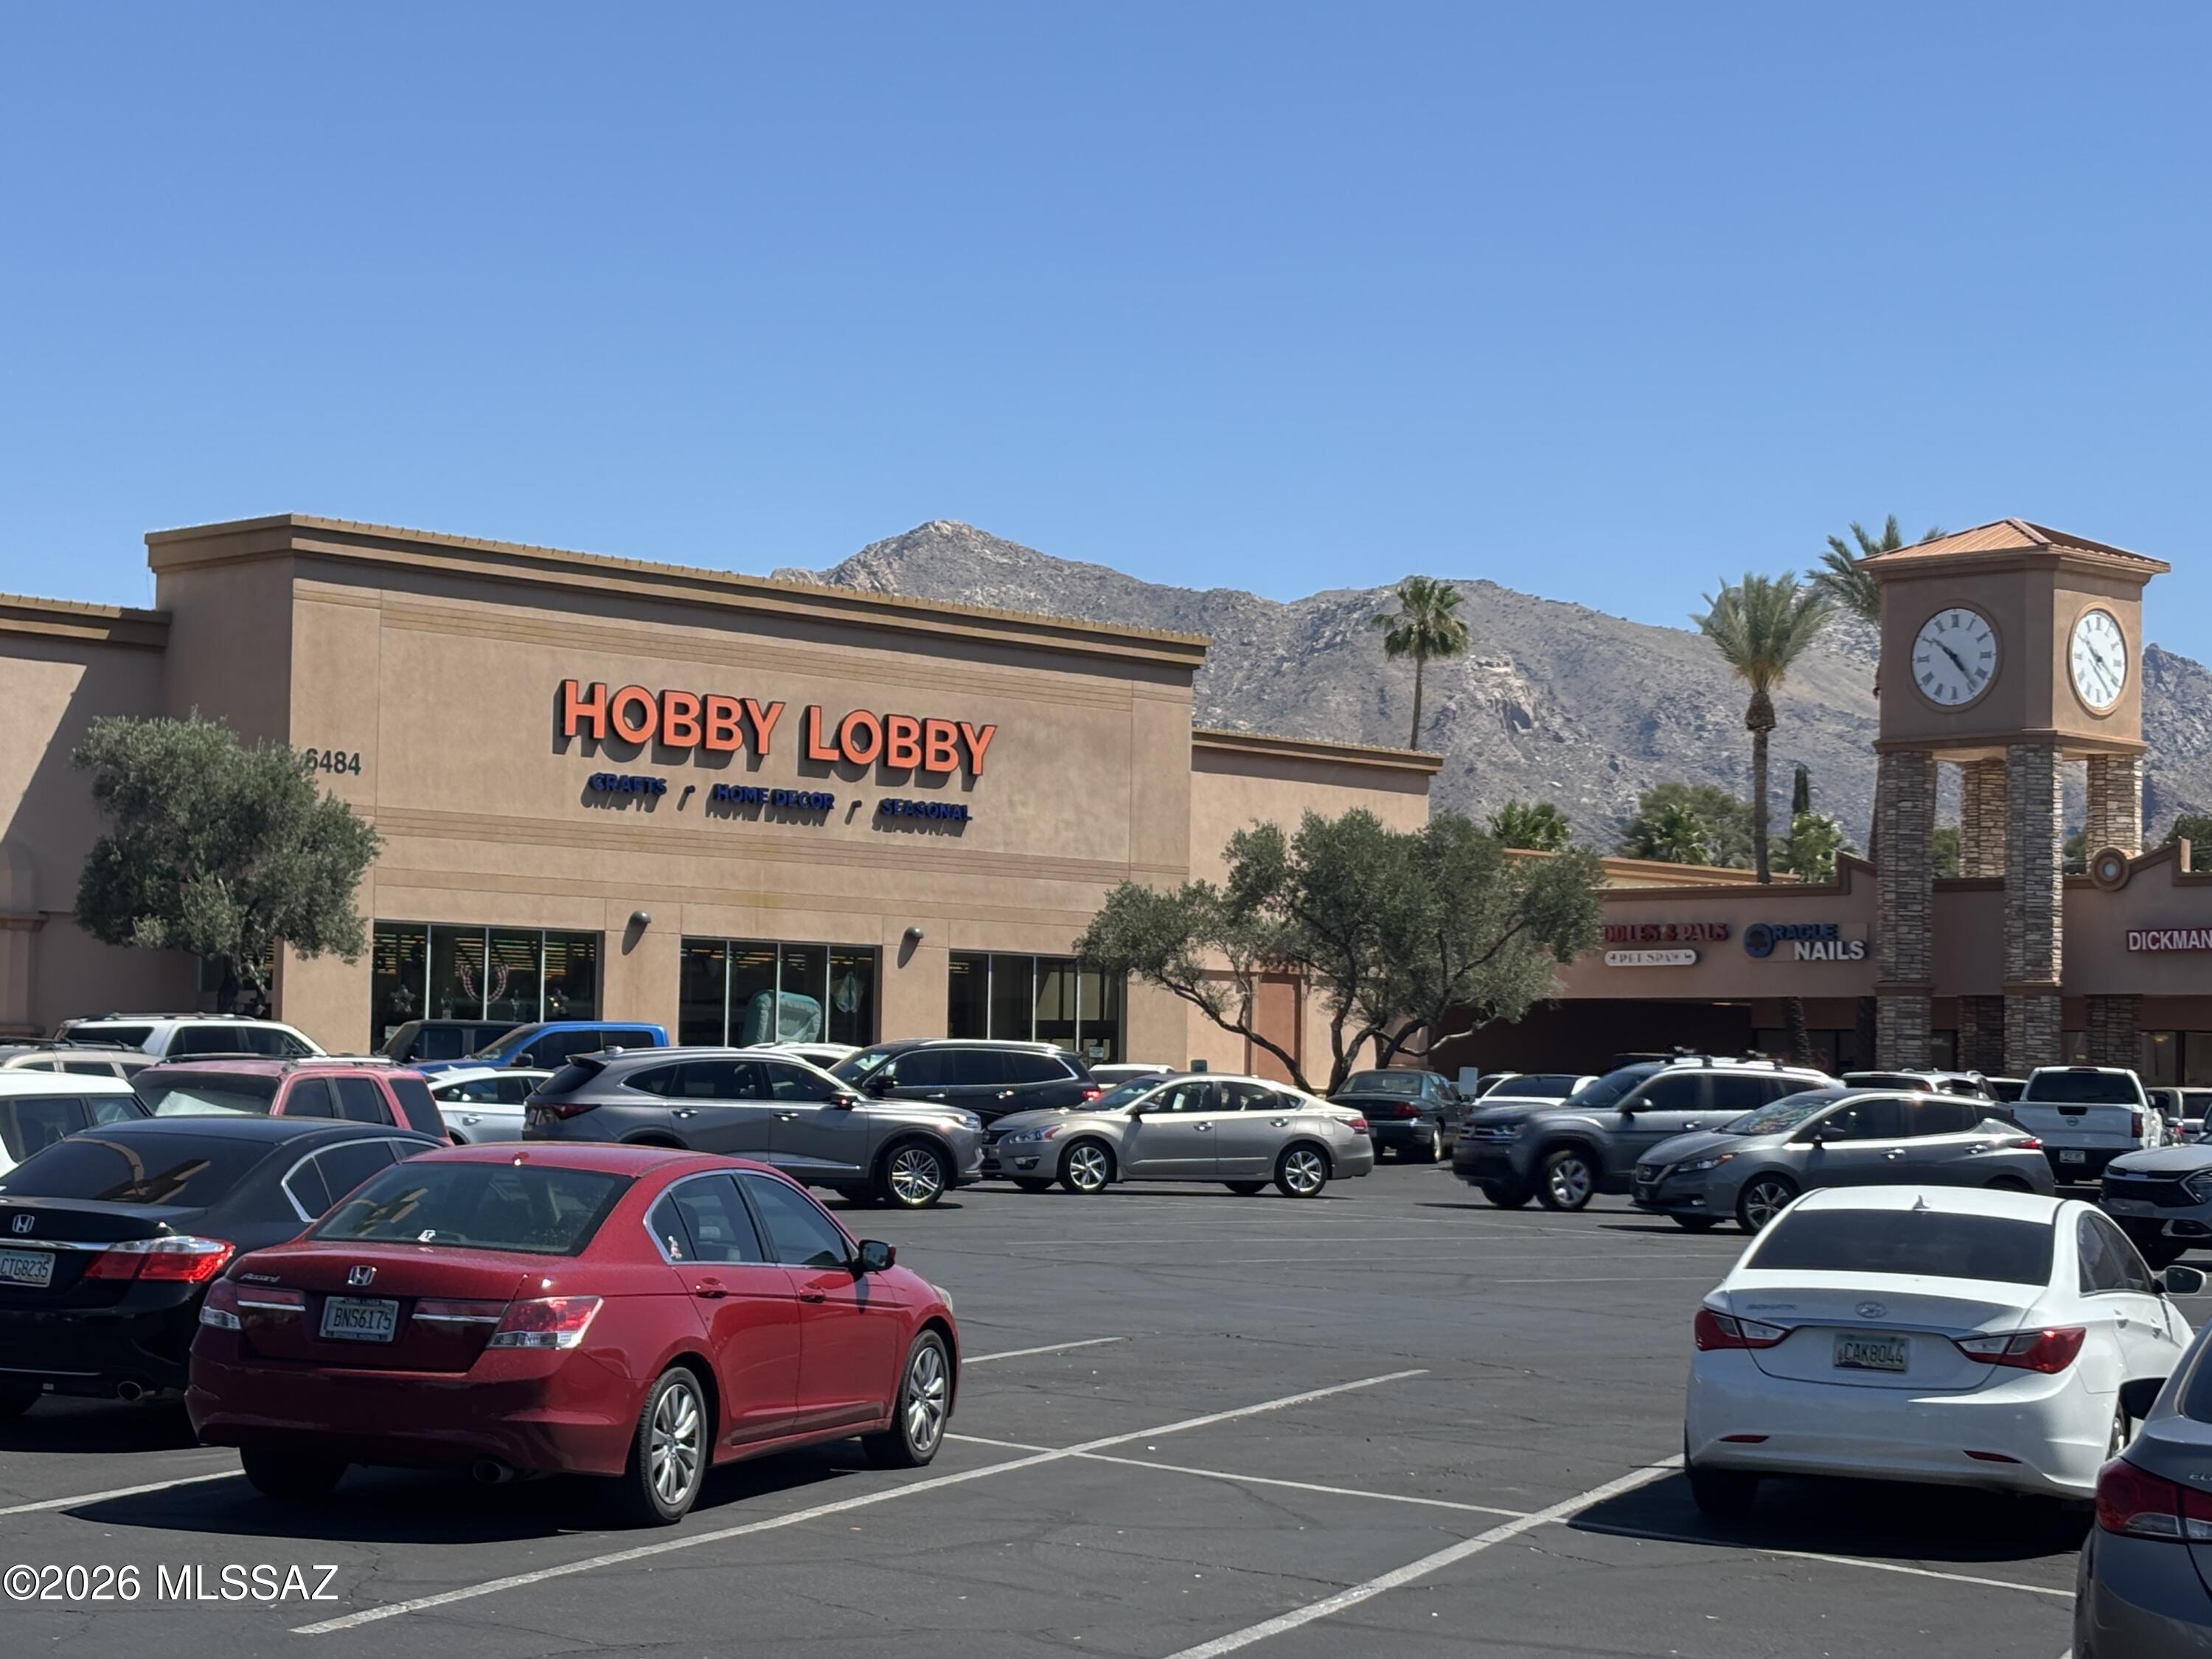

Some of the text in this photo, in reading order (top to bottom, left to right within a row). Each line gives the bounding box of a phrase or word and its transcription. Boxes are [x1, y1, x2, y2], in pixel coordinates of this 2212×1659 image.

[561, 679, 998, 776] HOBBY LOBBY
[305, 748, 361, 776] 6484
[591, 773, 973, 821] CRAFTS HOME DECOR SEASONAL
[1744, 923, 1839, 958] ORACLE
[1794, 940, 1865, 960] NAILS
[2128, 929, 2212, 950] DICKMAN
[333, 1307, 392, 1330] BNS6175
[1844, 1342, 1904, 1364] CAK8044
